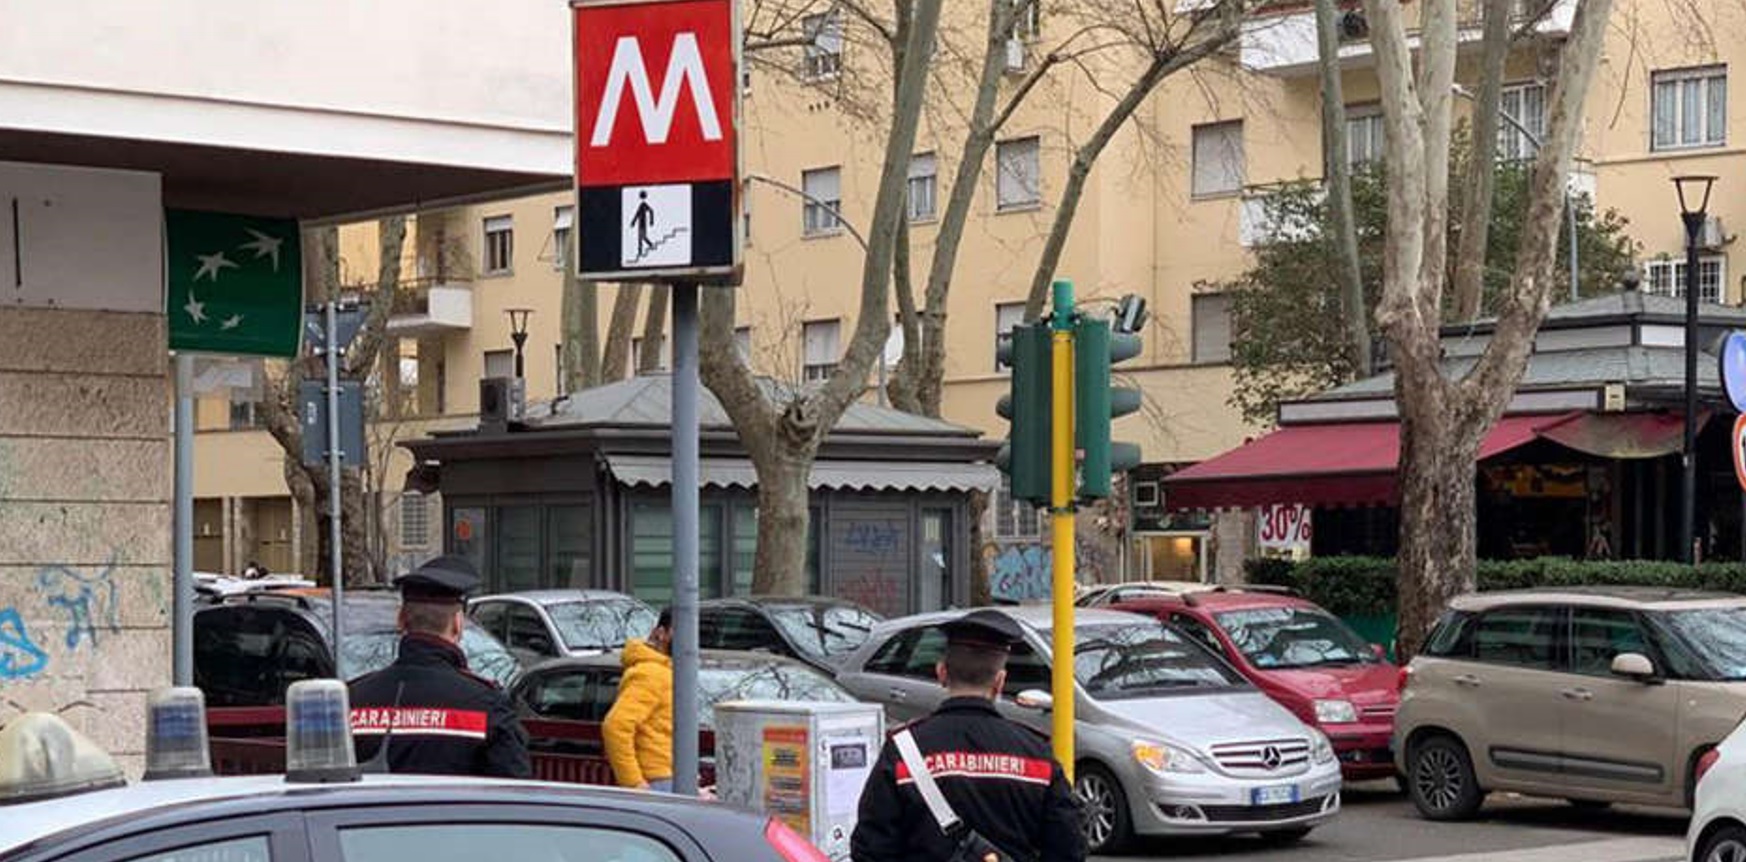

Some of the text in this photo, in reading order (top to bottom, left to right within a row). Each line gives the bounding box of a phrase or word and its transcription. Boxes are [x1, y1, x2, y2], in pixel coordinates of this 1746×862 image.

[590, 31, 723, 147] M
[350, 708, 447, 727] CARABINIERI
[923, 752, 1025, 775] CARABINIERI
